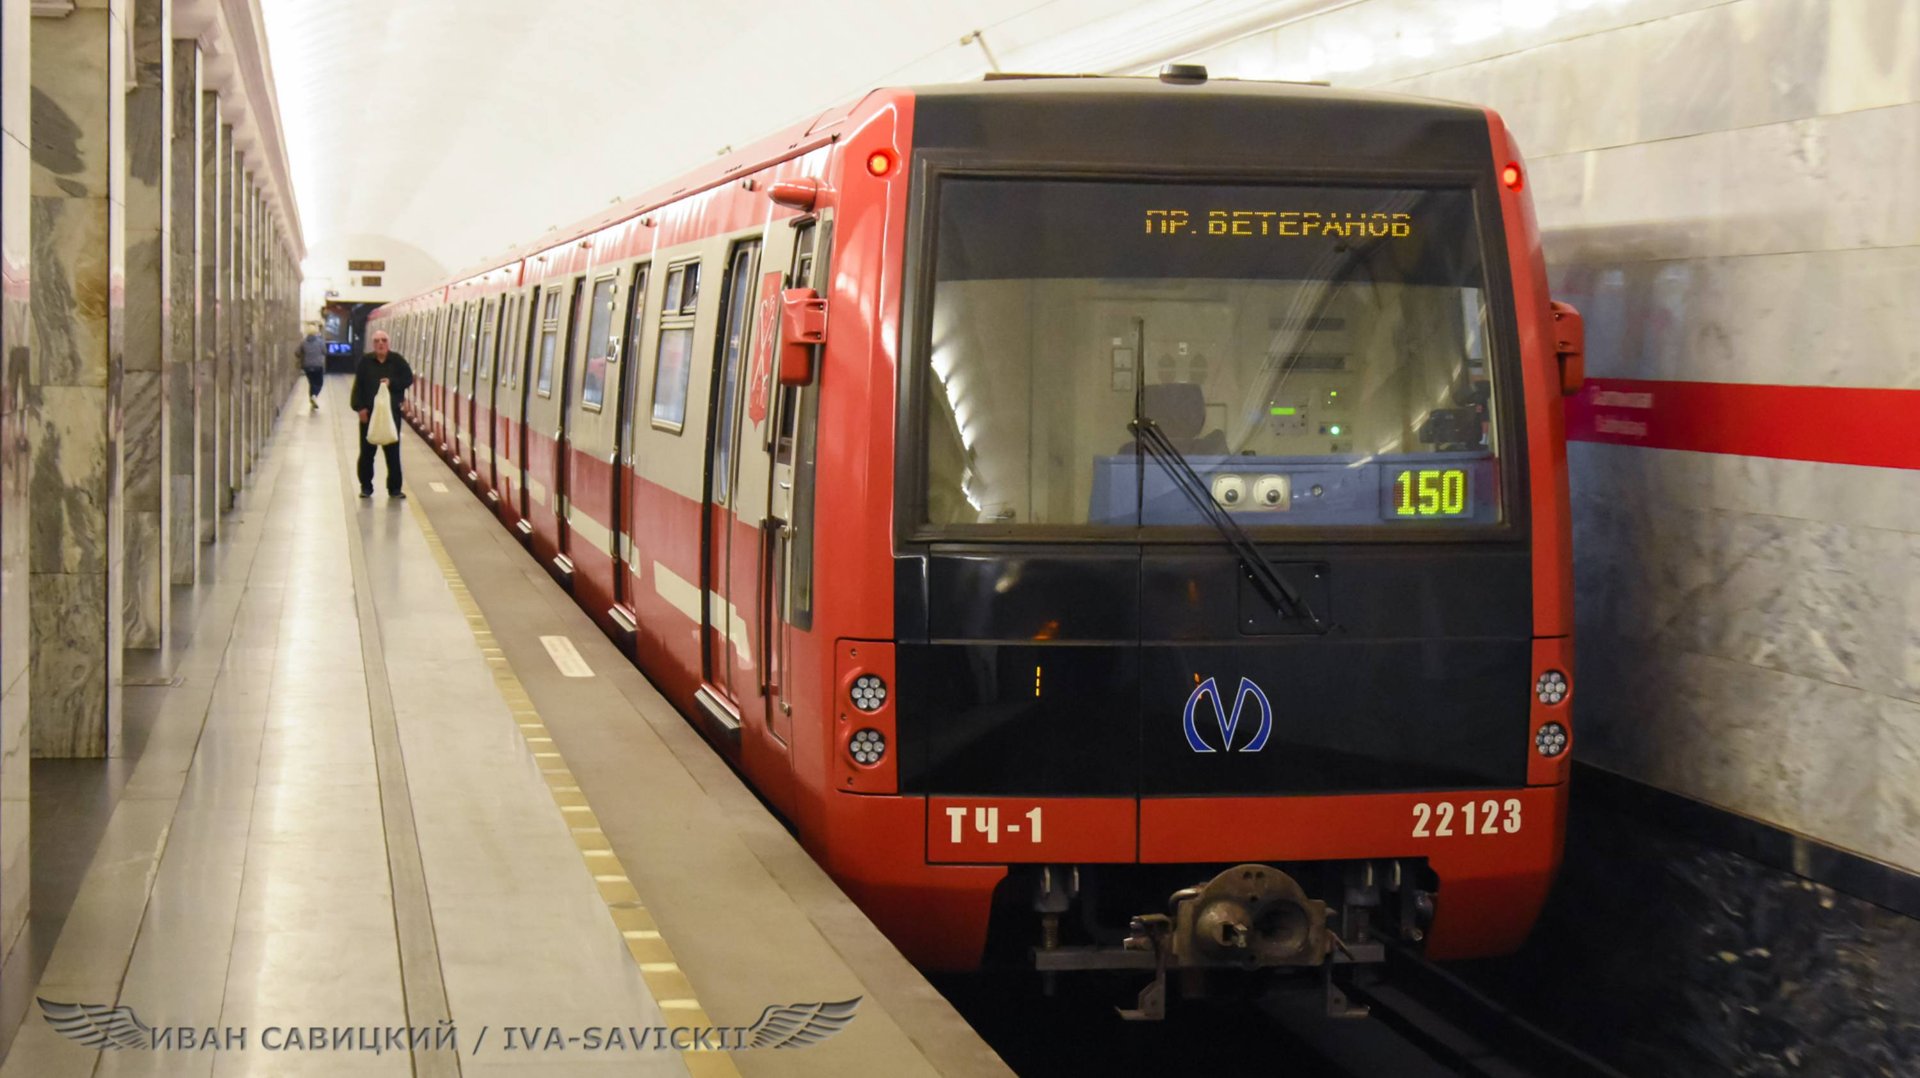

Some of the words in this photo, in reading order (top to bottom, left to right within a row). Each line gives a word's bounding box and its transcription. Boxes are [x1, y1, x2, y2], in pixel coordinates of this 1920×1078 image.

[1145, 210, 1197, 235] ПР.
[1208, 211, 1411, 237] ВЕТЕРАНОВ
[1397, 470, 1464, 515] 150
[946, 807, 1042, 843] ТЧ-1
[1412, 798, 1522, 838] 22123
